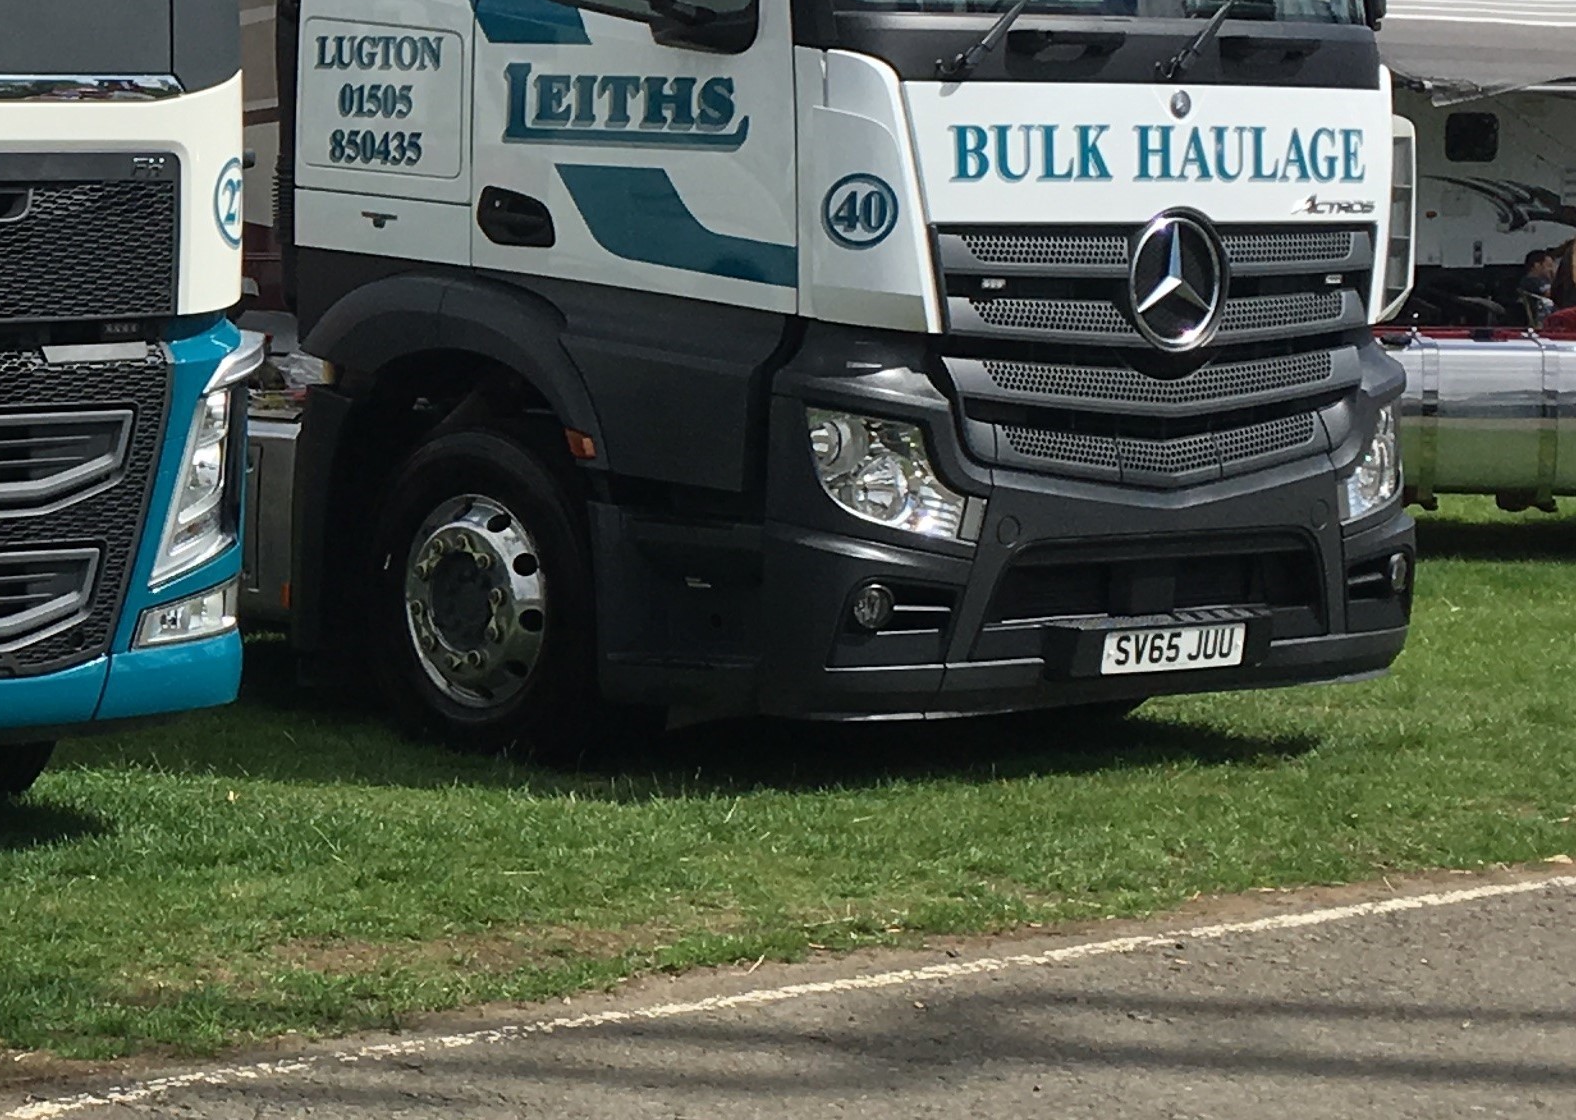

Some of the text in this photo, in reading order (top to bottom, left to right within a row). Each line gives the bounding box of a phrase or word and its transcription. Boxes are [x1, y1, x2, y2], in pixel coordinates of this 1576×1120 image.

[313, 35, 444, 72] LUGTON
[338, 82, 414, 119] 01505
[501, 62, 750, 153] LEITHS
[329, 128, 424, 167] 850435
[947, 123, 1366, 183] BULK HAULAGE
[832, 189, 888, 233] 40
[1114, 627, 1236, 666] SV65 JUU
